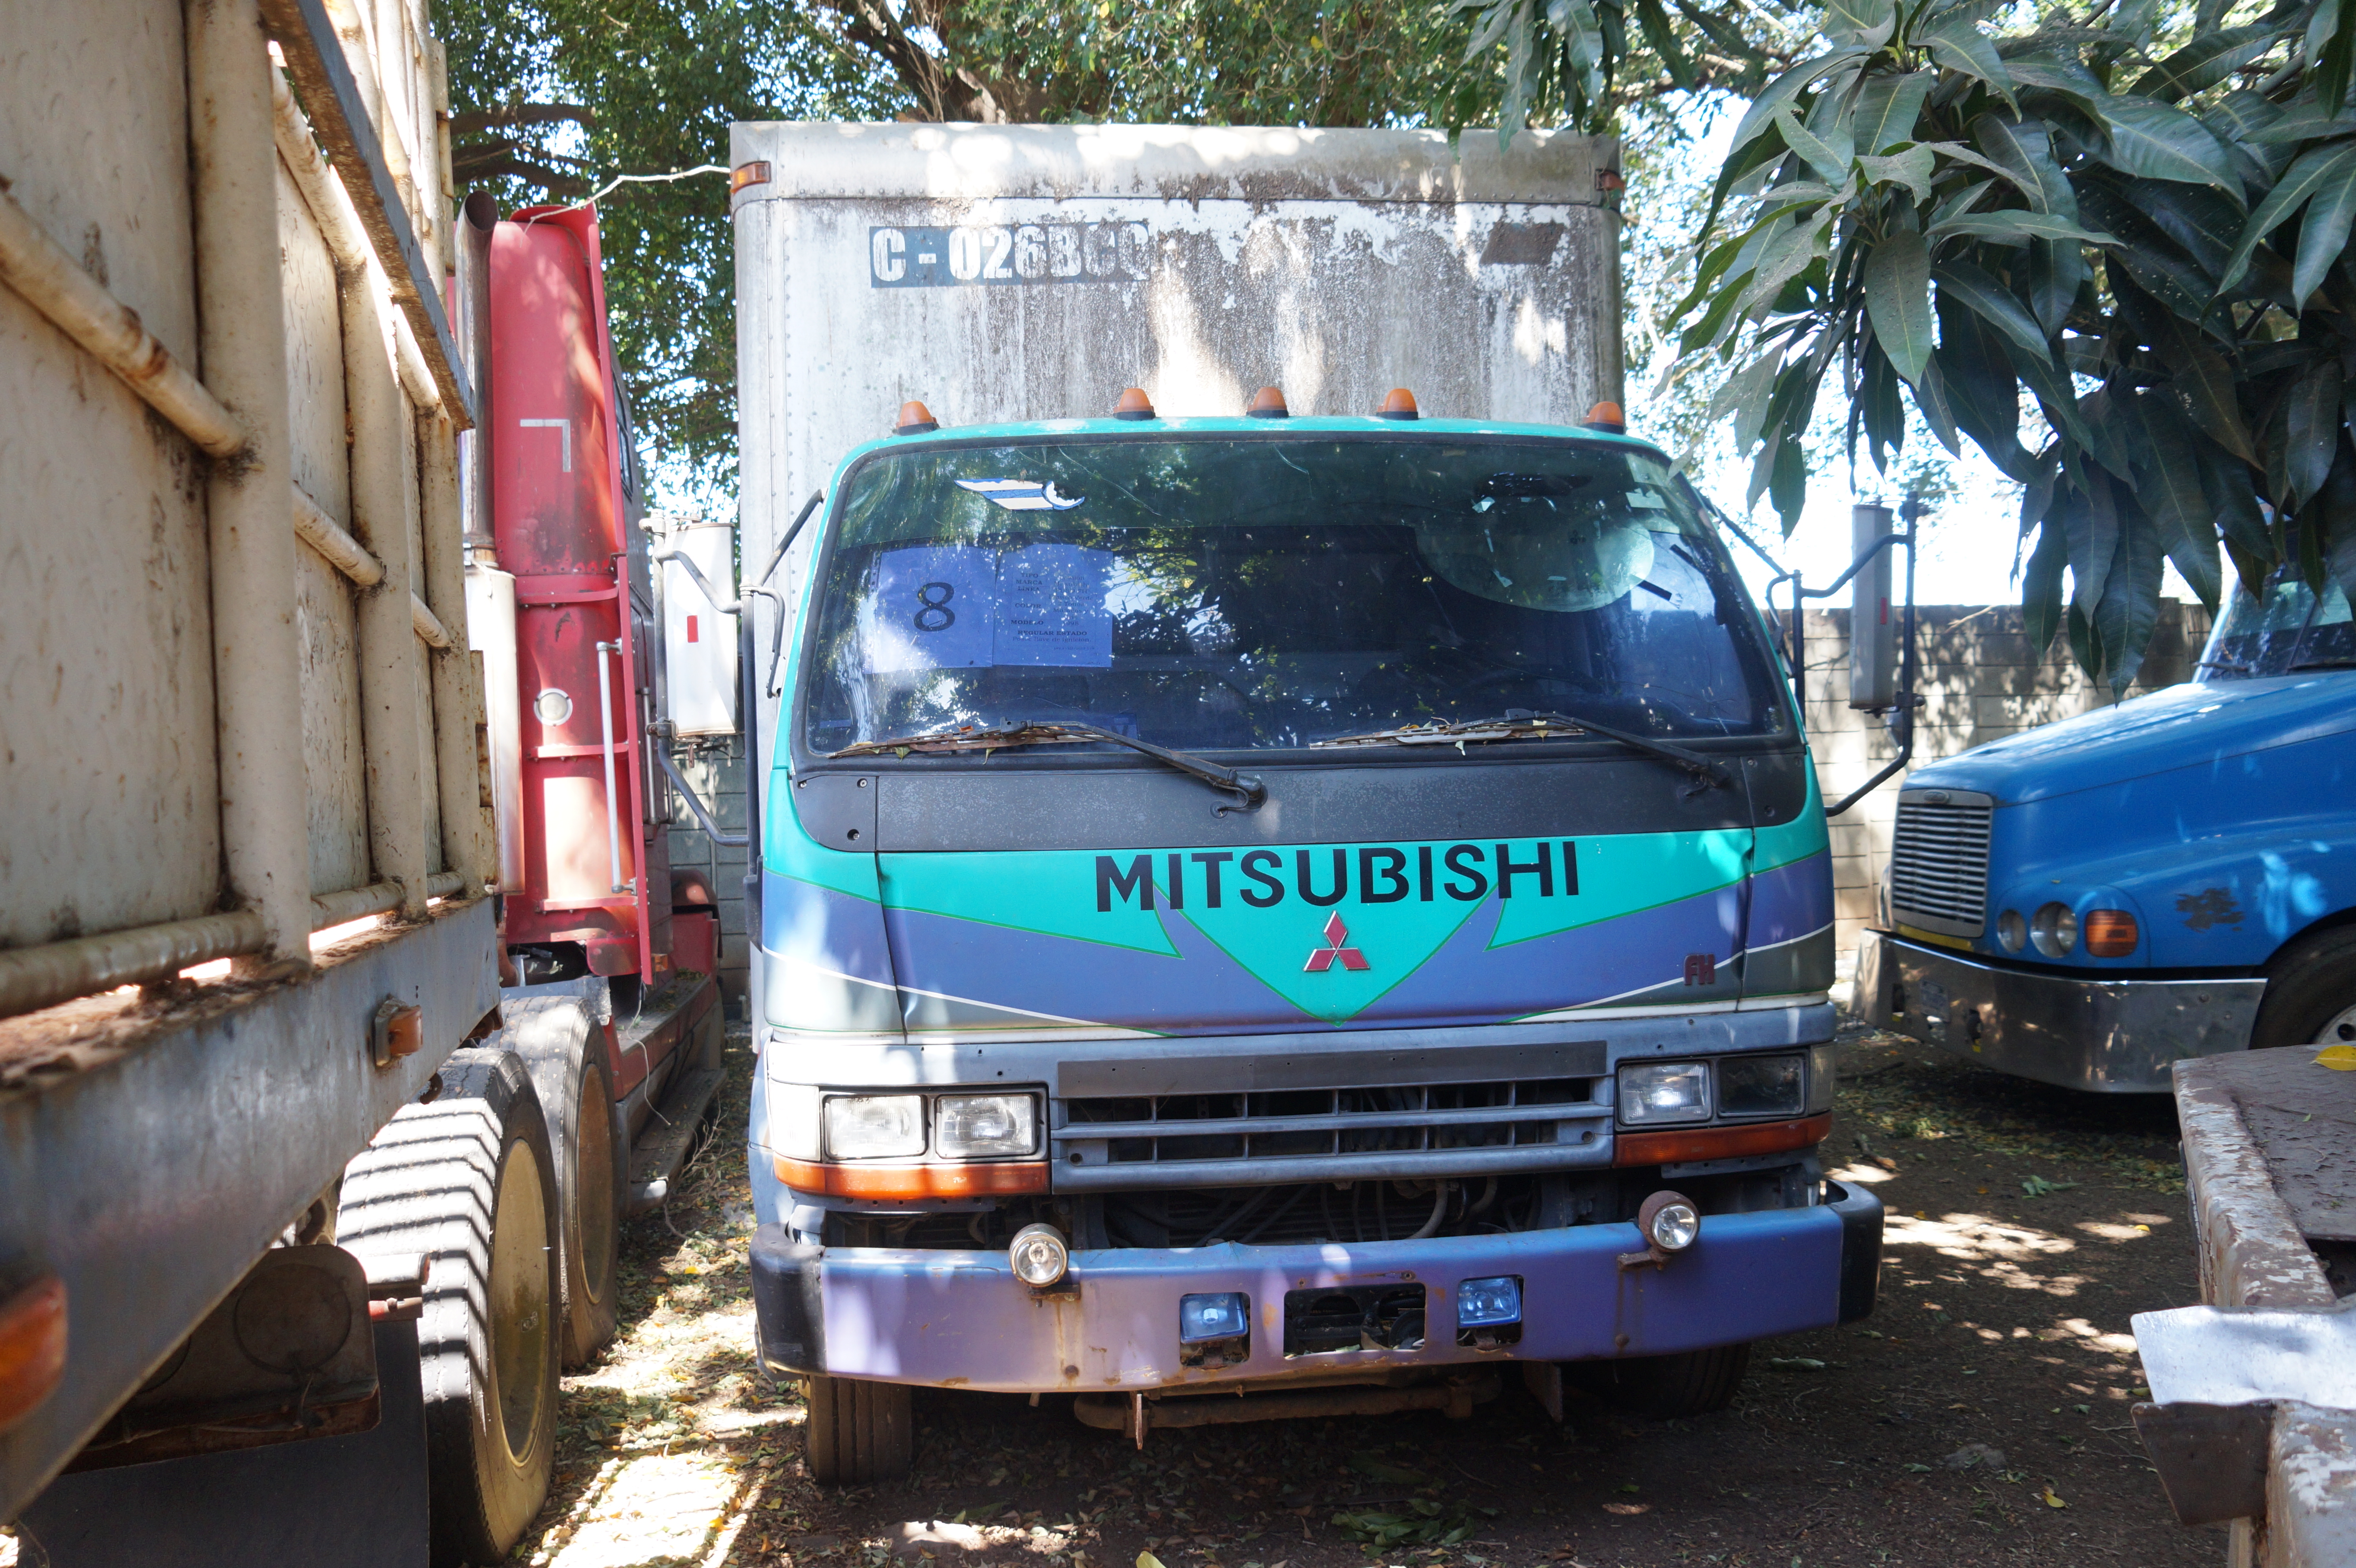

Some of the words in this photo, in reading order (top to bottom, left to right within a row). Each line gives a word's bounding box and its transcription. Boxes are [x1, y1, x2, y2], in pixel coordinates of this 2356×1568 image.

[914, 582, 955, 632] 8
[1096, 841, 1579, 911] MITSUBISHI
[1684, 954, 1715, 985] FH
